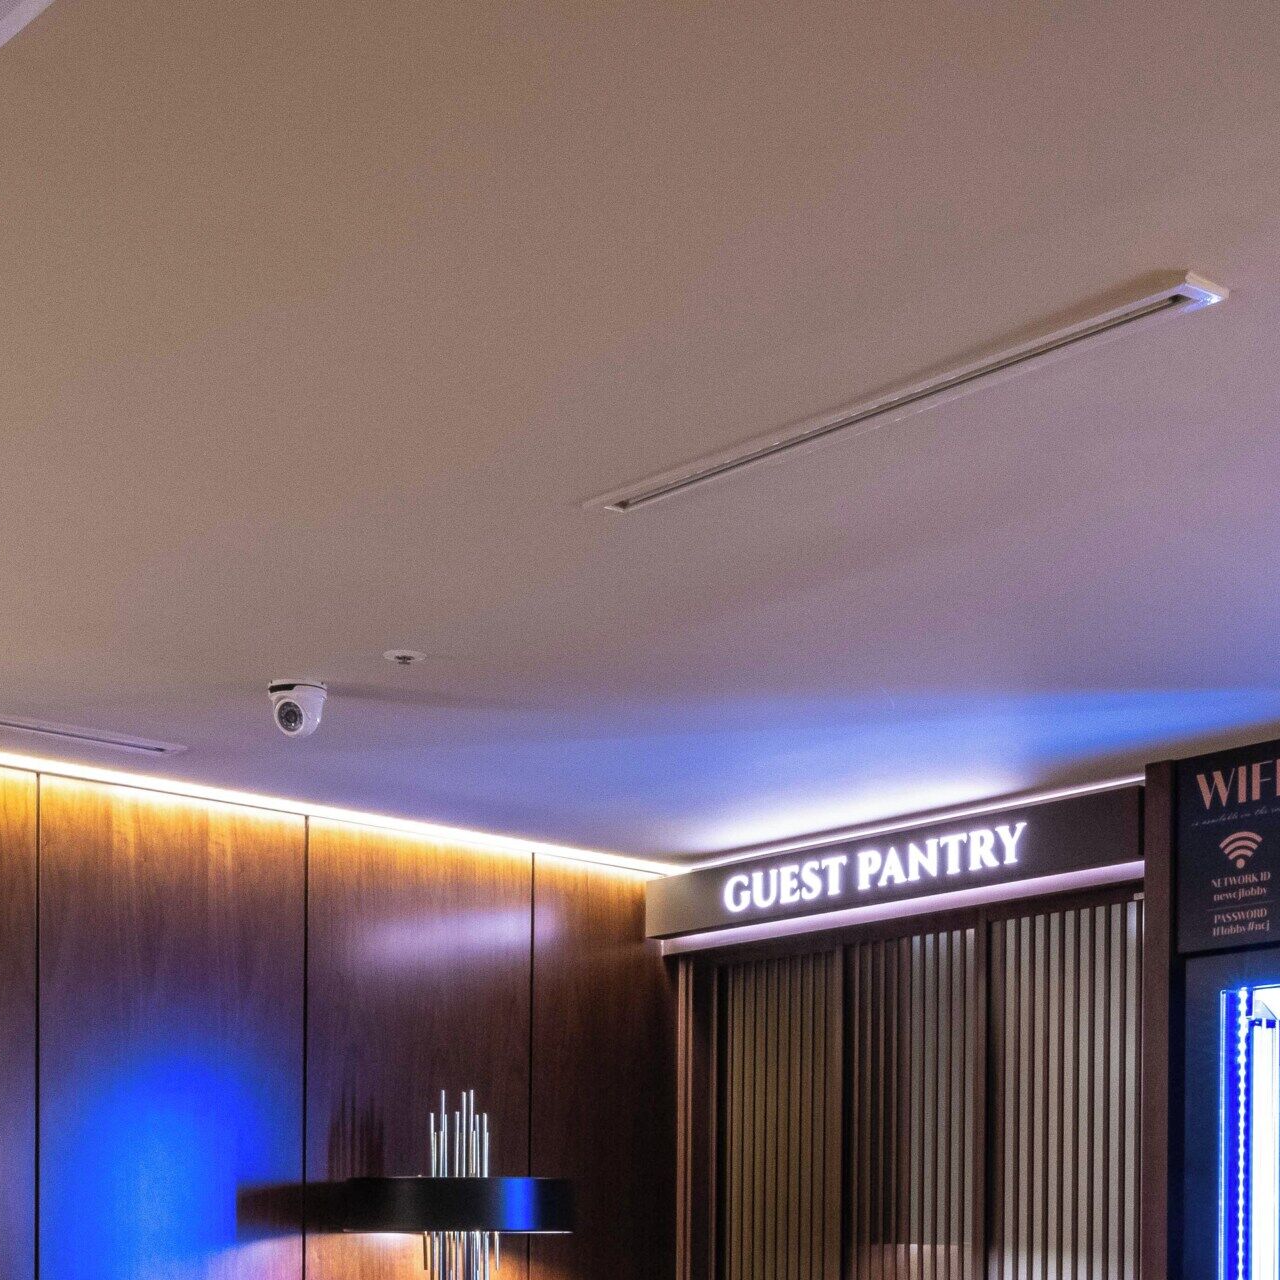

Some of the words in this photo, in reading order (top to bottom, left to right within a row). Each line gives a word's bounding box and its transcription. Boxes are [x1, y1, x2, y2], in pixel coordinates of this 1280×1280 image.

[723, 855, 848, 913] GUEST
[857, 822, 1028, 890] PANTRY
[1211, 873, 1259, 888] NETWORK
[1260, 871, 1271, 881] ID
[1214, 907, 1268, 924] PASSWORD
